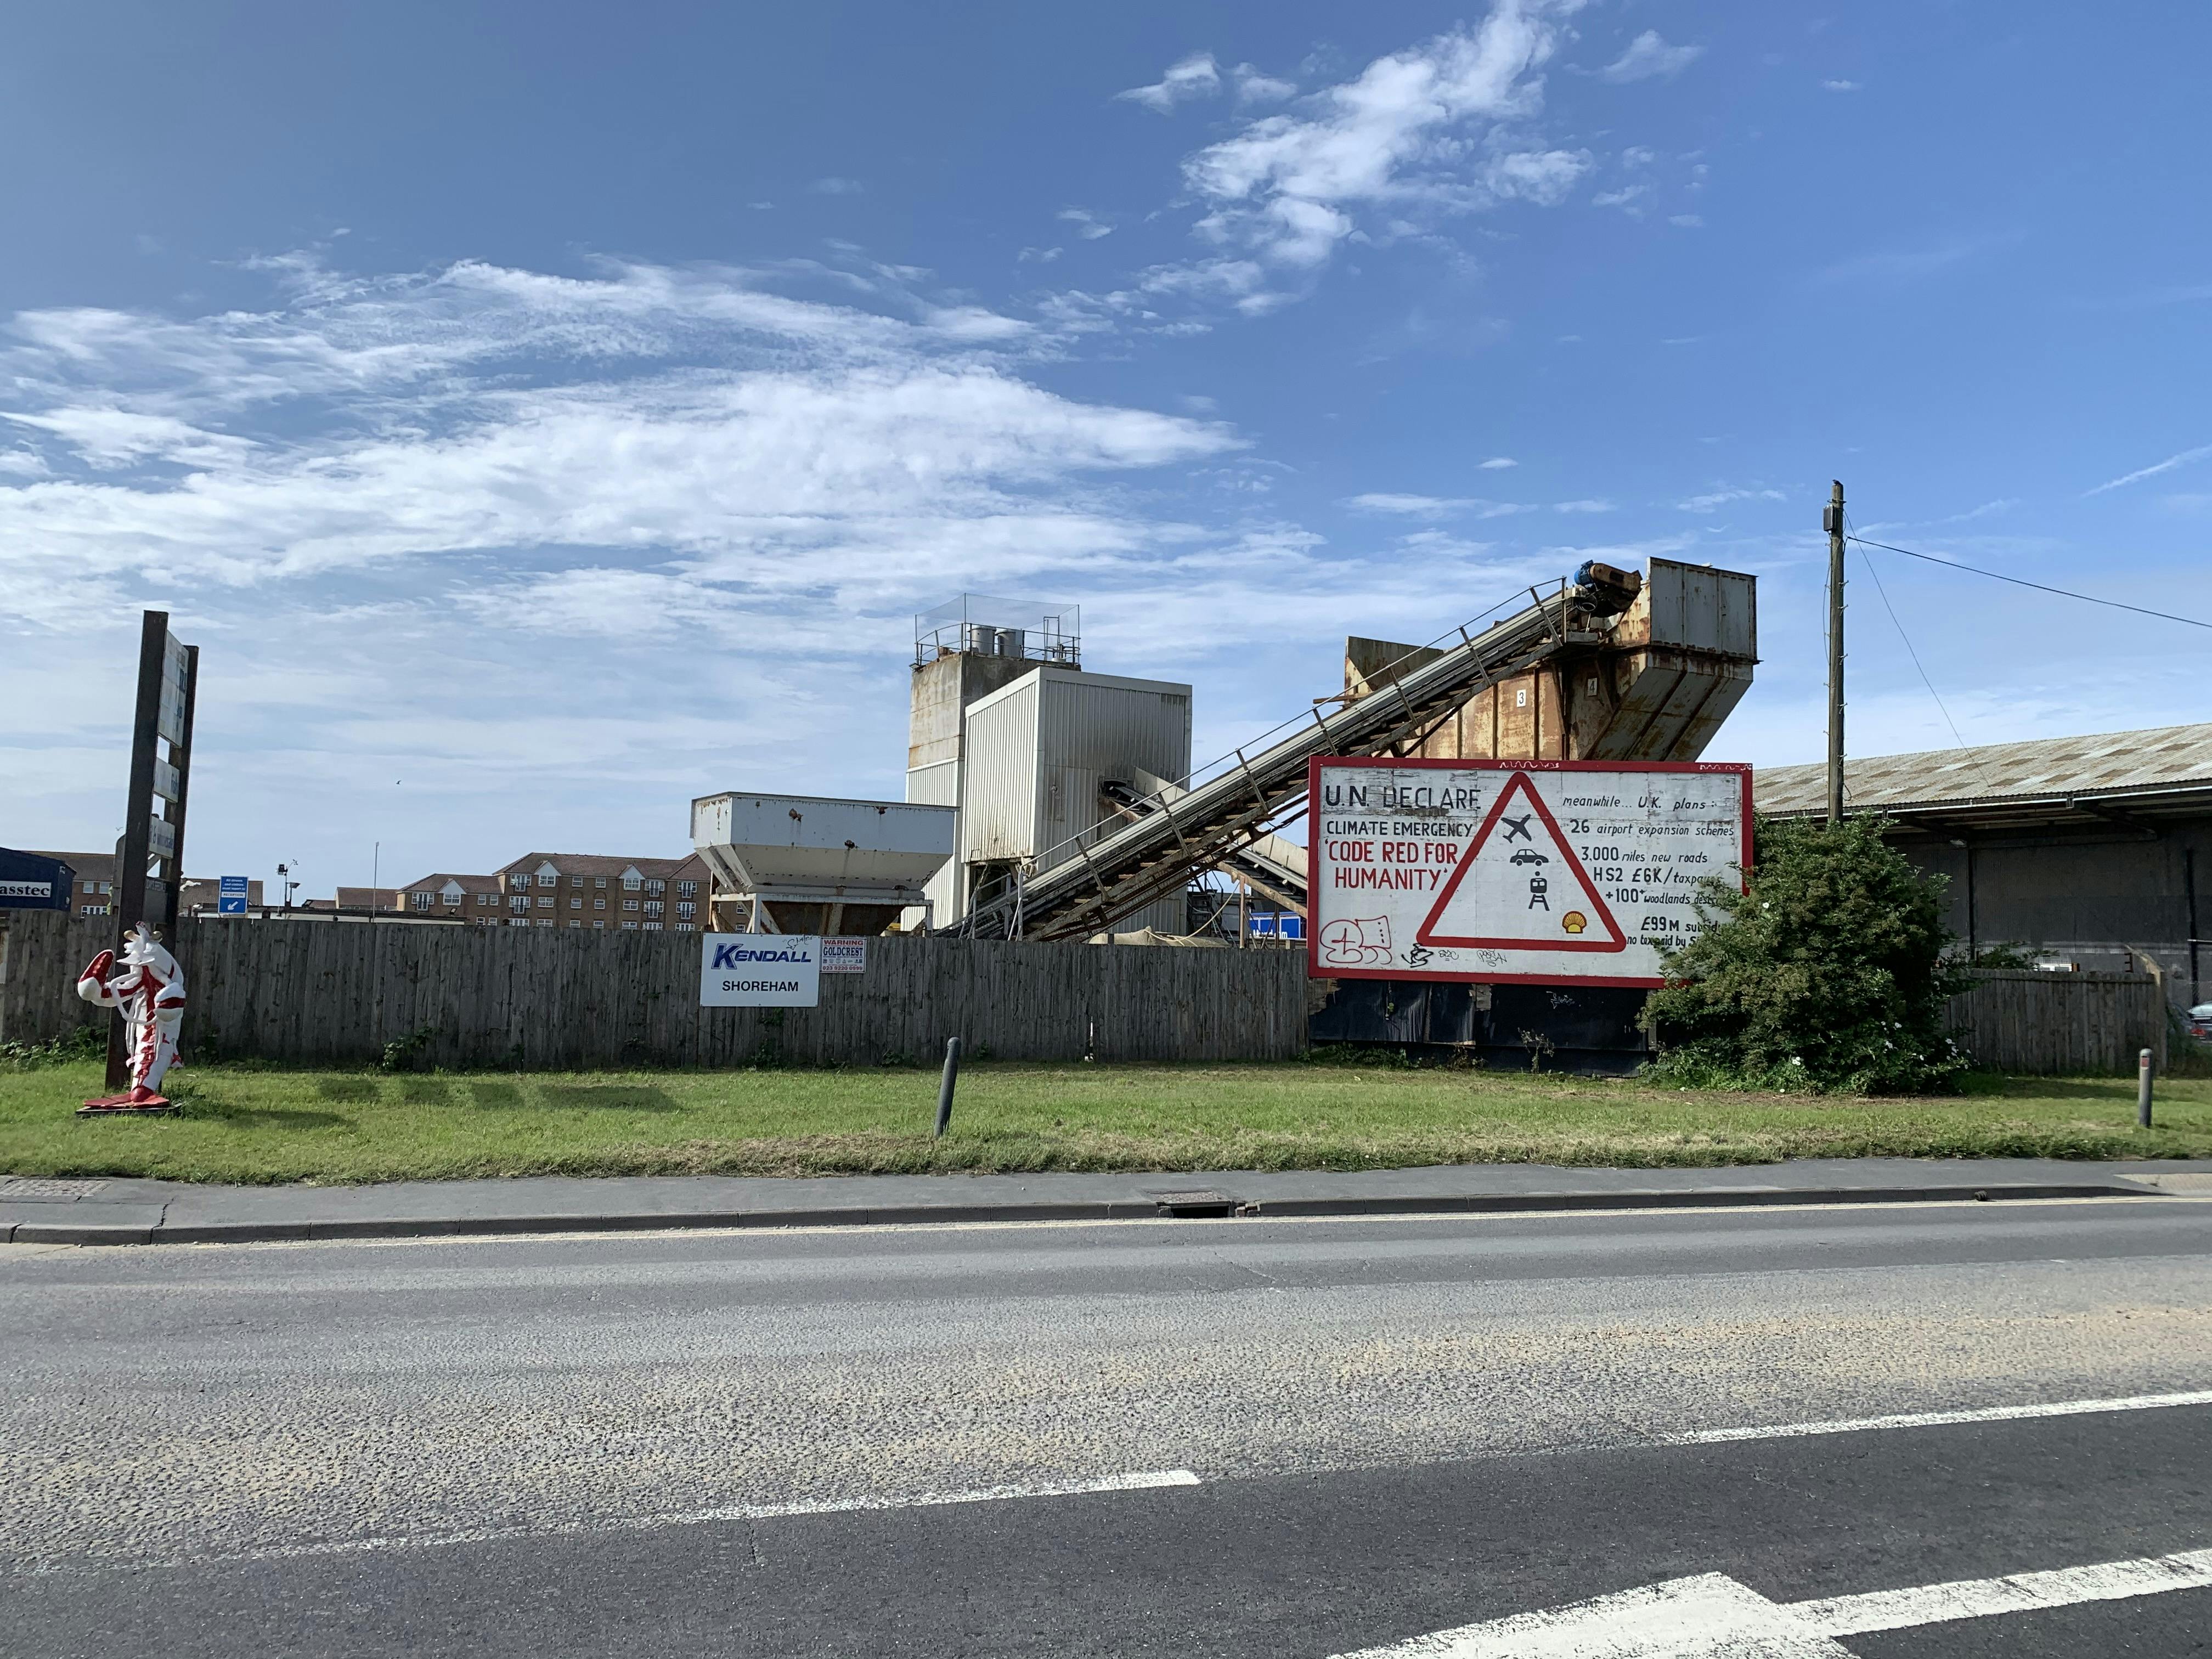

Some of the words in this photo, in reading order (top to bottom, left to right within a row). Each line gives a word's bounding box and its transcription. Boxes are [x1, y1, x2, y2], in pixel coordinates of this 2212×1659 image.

[1590, 680, 1595, 693] 4
[1519, 692, 1524, 704] 3
[1325, 785, 1369, 806] U.N.
[1383, 787, 1481, 809] DECLARE
[1563, 795, 1633, 808] meanwhile...
[1638, 796, 1662, 809] U.K.
[1327, 821, 1388, 836] CLIMATE
[1393, 822, 1473, 837] EMERGENCY
[1570, 819, 1590, 834] 26
[1597, 823, 1633, 837] airport
[1638, 825, 1689, 838] expansion
[1695, 825, 1734, 837] schemes
[1383, 842, 1419, 864] RED
[1425, 842, 1458, 865] FOR
[1581, 847, 1619, 862] 3,000
[1622, 850, 1645, 862] miles
[1651, 854, 1671, 862] new
[1679, 851, 1708, 863] roads
[1594, 867, 1623, 883] HS2
[1644, 892, 1691, 905] woodlands
[1627, 936, 1637, 945] no
[1640, 934, 1654, 945] tax
[1655, 934, 1673, 946] aid
[1675, 935, 1686, 950] by
[711, 943, 811, 970] KENDALL
[823, 946, 863, 956] GOLDCREST
[722, 980, 799, 992] SHOREHAM
